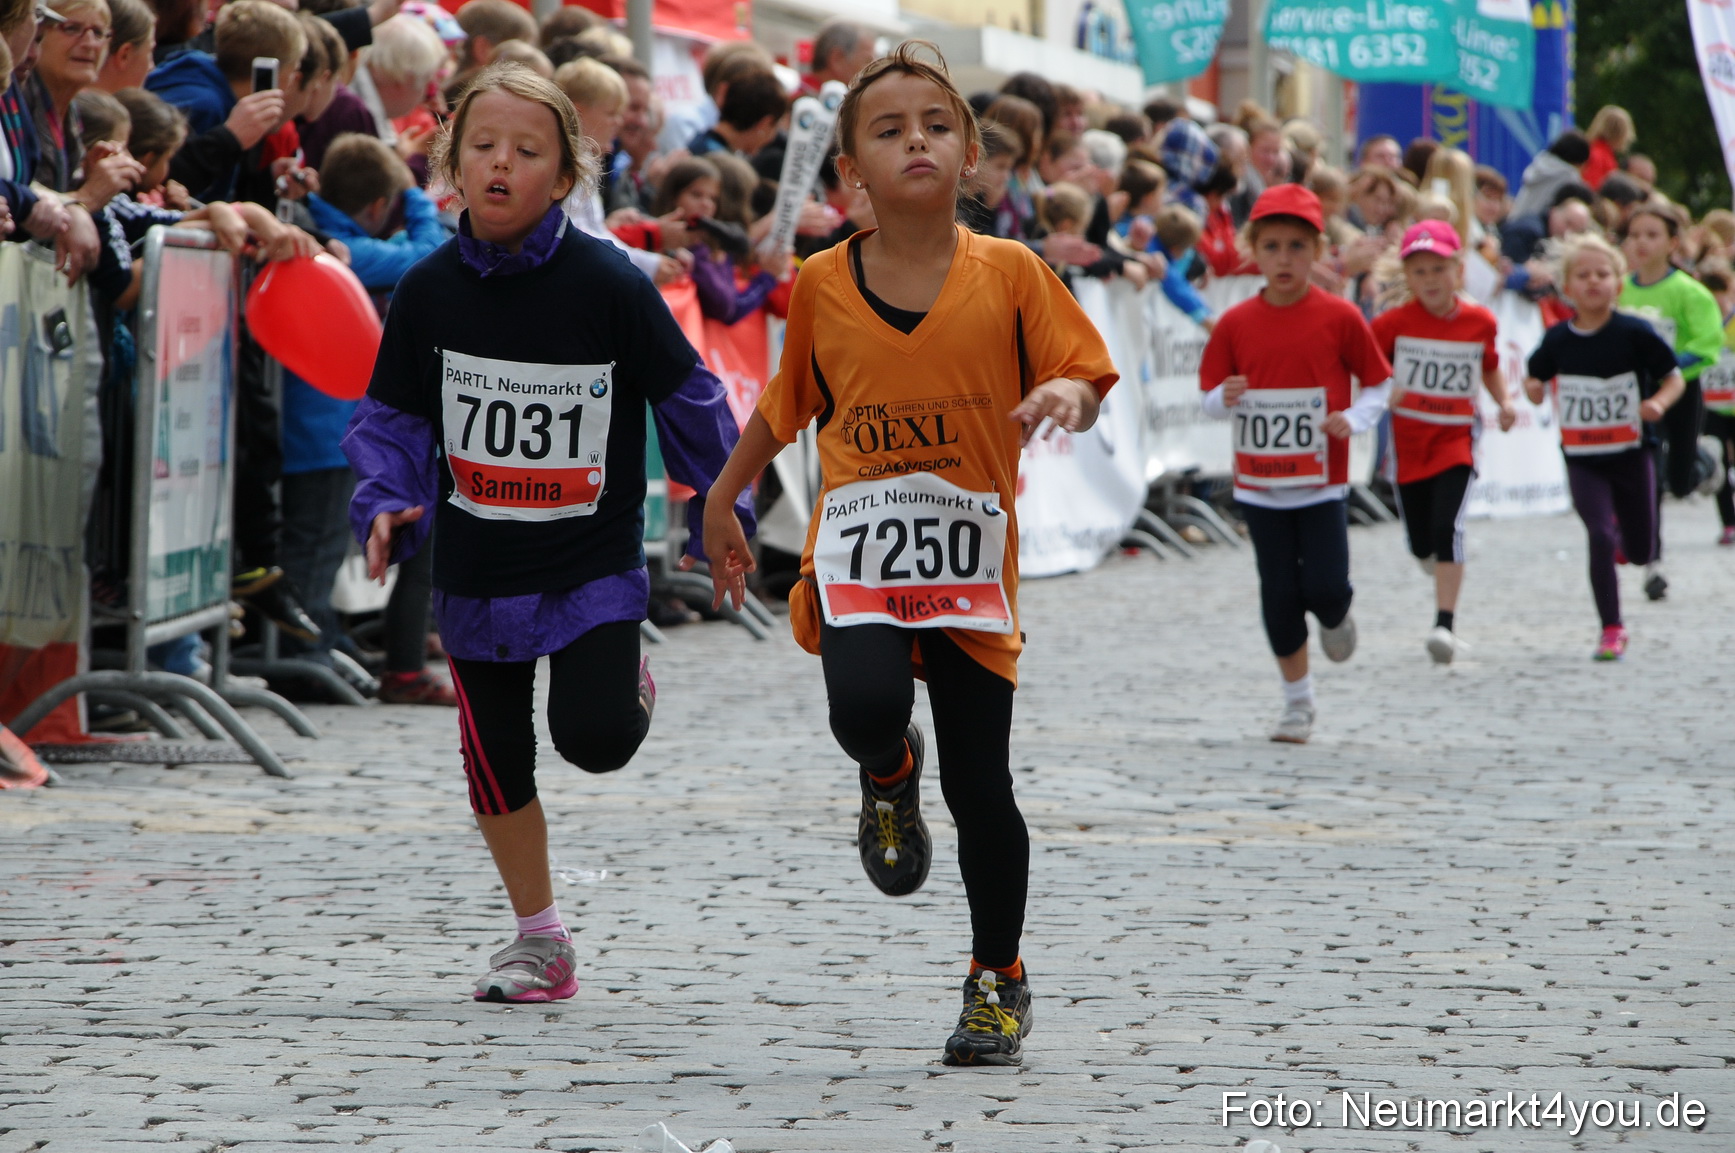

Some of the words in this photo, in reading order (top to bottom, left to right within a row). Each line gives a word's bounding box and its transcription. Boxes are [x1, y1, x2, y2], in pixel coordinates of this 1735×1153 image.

[1348, 33, 1429, 69] 6352
[446, 367, 493, 391] PARTL
[497, 376, 583, 397] Neumarkt
[1404, 358, 1472, 392] 7023
[890, 402, 925, 415] UHREN
[927, 399, 949, 411] UND
[1562, 393, 1628, 423] 7032
[456, 393, 584, 461] 7031
[853, 413, 959, 455] OEXL
[1236, 413, 1313, 449] 7026
[589, 453, 600, 465] W
[471, 471, 562, 502] Samina
[825, 493, 880, 521] PARTL
[884, 488, 974, 512] Neumarkt
[840, 517, 982, 582] 7250
[985, 567, 996, 580] W
[886, 595, 955, 621] Alicia
